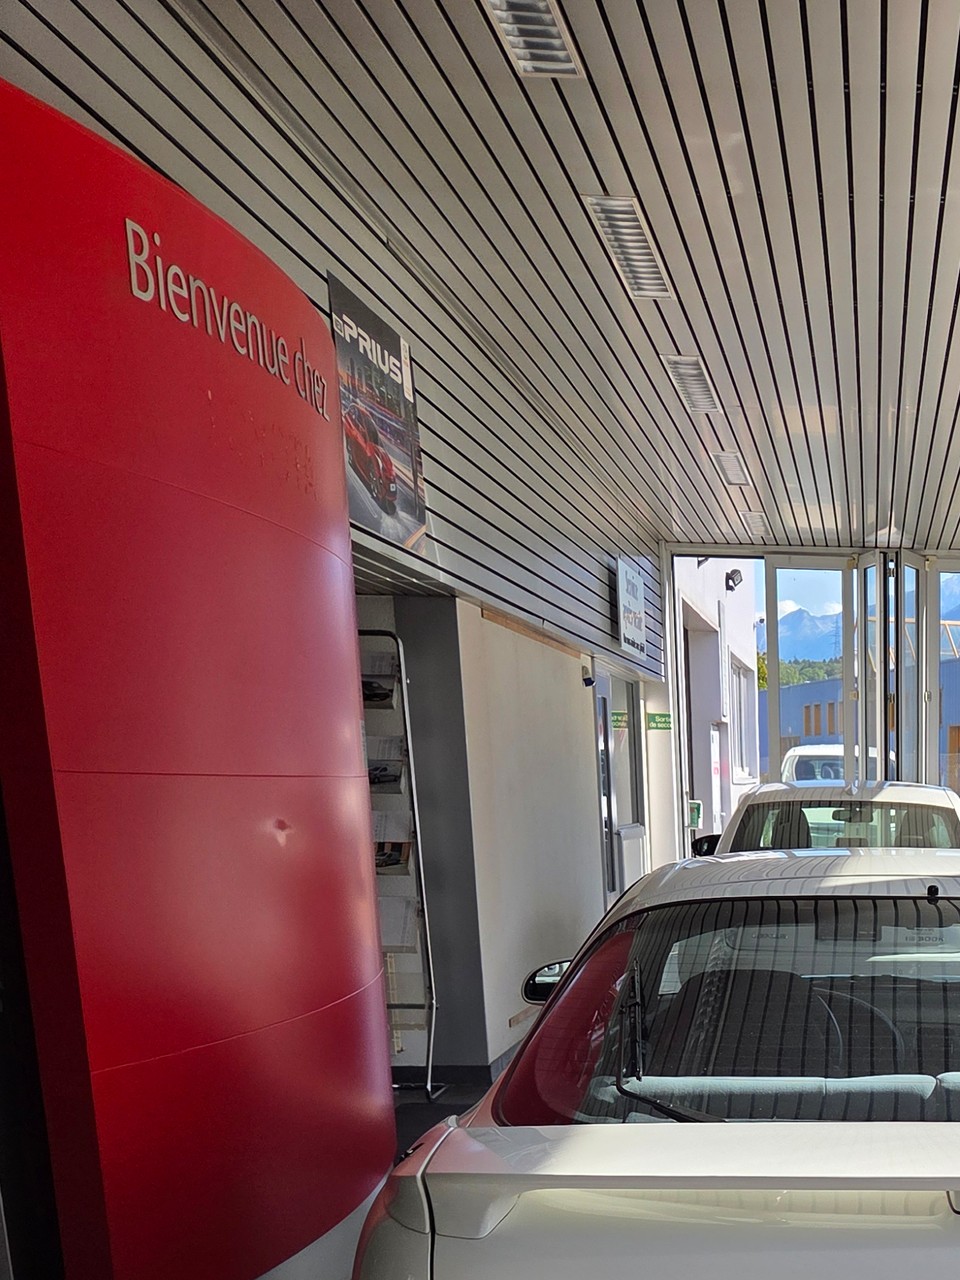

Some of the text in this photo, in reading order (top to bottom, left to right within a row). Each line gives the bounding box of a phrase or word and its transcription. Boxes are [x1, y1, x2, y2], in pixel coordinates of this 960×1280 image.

[125, 217, 331, 422] Bienvenue chez
[342, 313, 403, 386] PRIUS
